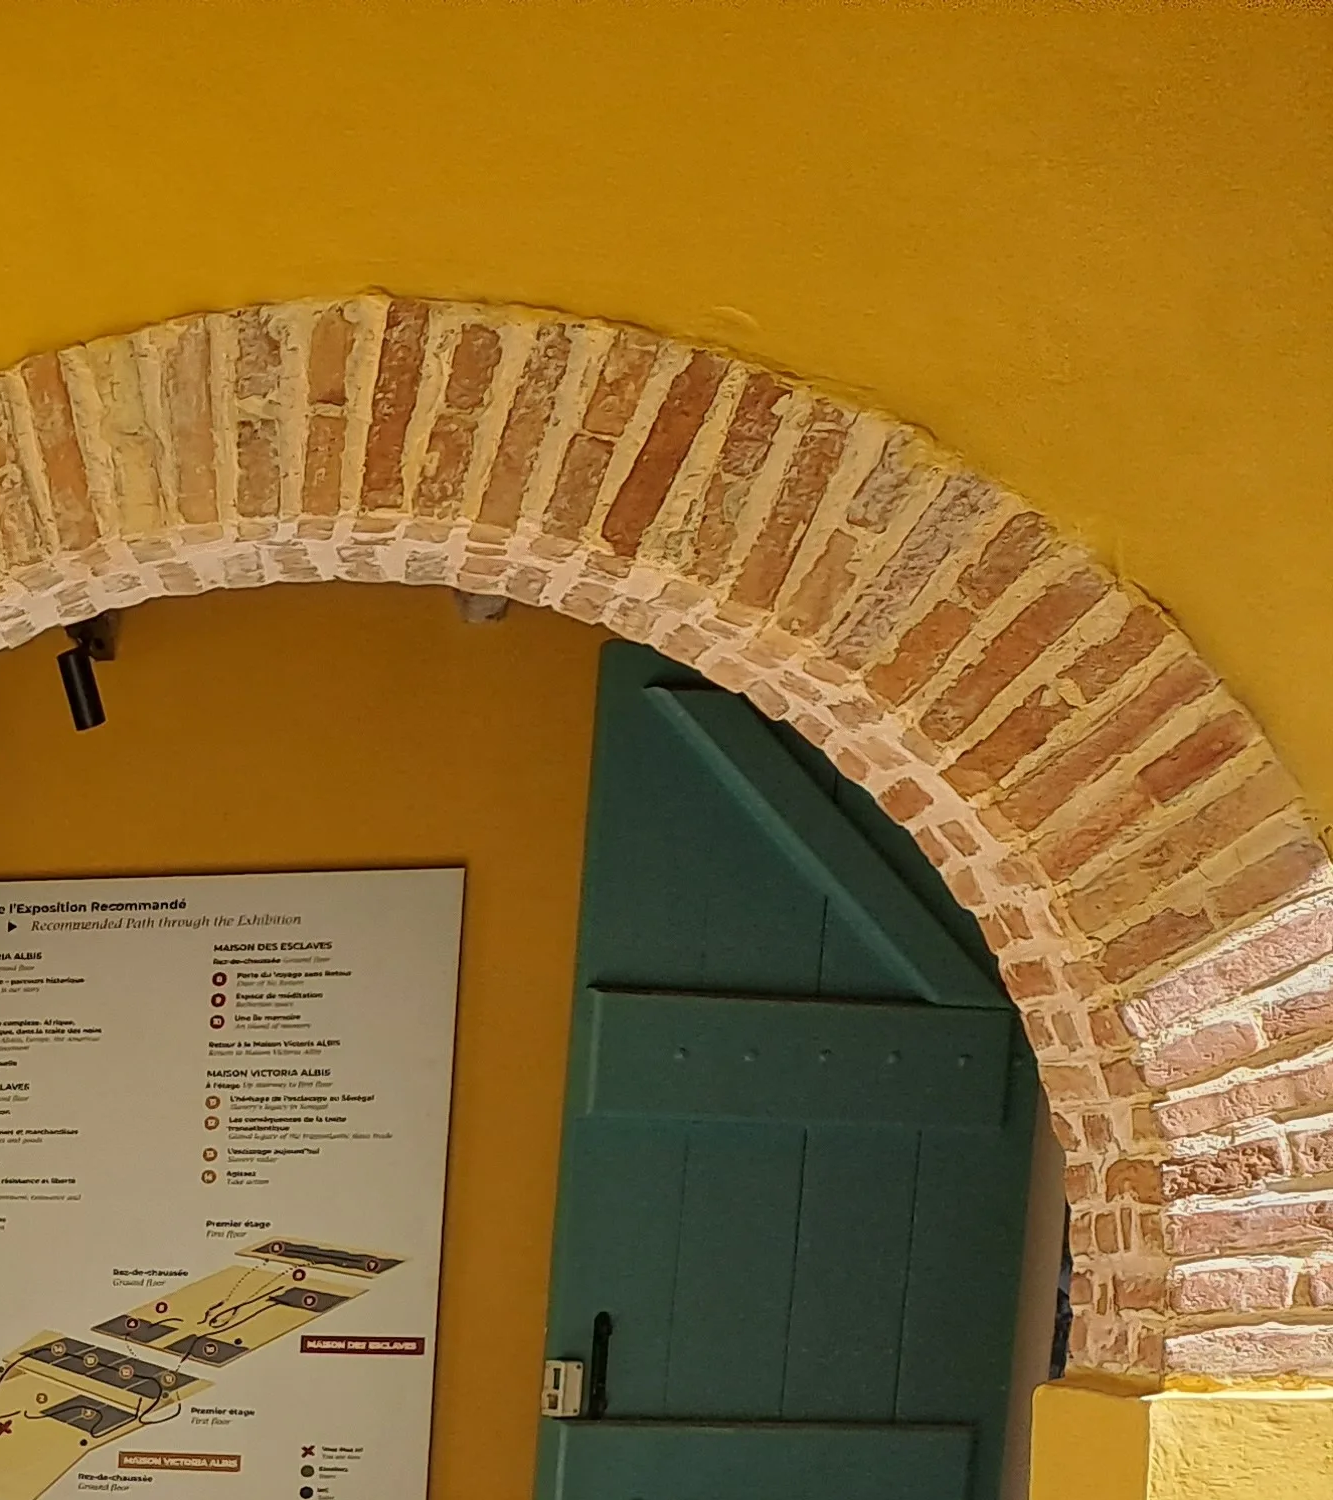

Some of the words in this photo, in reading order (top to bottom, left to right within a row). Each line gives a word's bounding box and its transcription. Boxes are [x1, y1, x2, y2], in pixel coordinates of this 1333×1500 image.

[9, 901, 87, 915] l'Exposition
[91, 898, 187, 912] Recommandé
[31, 917, 123, 931] Recommended
[126, 915, 155, 929] Path
[158, 914, 209, 930] through
[214, 915, 235, 927] the
[237, 912, 302, 927] Exhibition
[214, 944, 255, 952] MAISON
[257, 943, 278, 951] DES
[280, 941, 333, 950] ESCLAVES
[14, 952, 42, 960] ALBIS
[207, 1069, 248, 1078] MAISON
[251, 1069, 298, 1077] VICTORIA
[301, 1069, 331, 1077] ALBIS
[206, 1219, 242, 1229] Premier
[244, 1219, 271, 1230] étage
[113, 1268, 189, 1277] Rez-de-chaussée
[307, 1341, 345, 1349] MAISON
[368, 1342, 417, 1350] ESCLAVES
[191, 1407, 226, 1415] Premier
[123, 1456, 162, 1465] MAISON
[78, 1473, 153, 1482] Rez-de-chaussée
